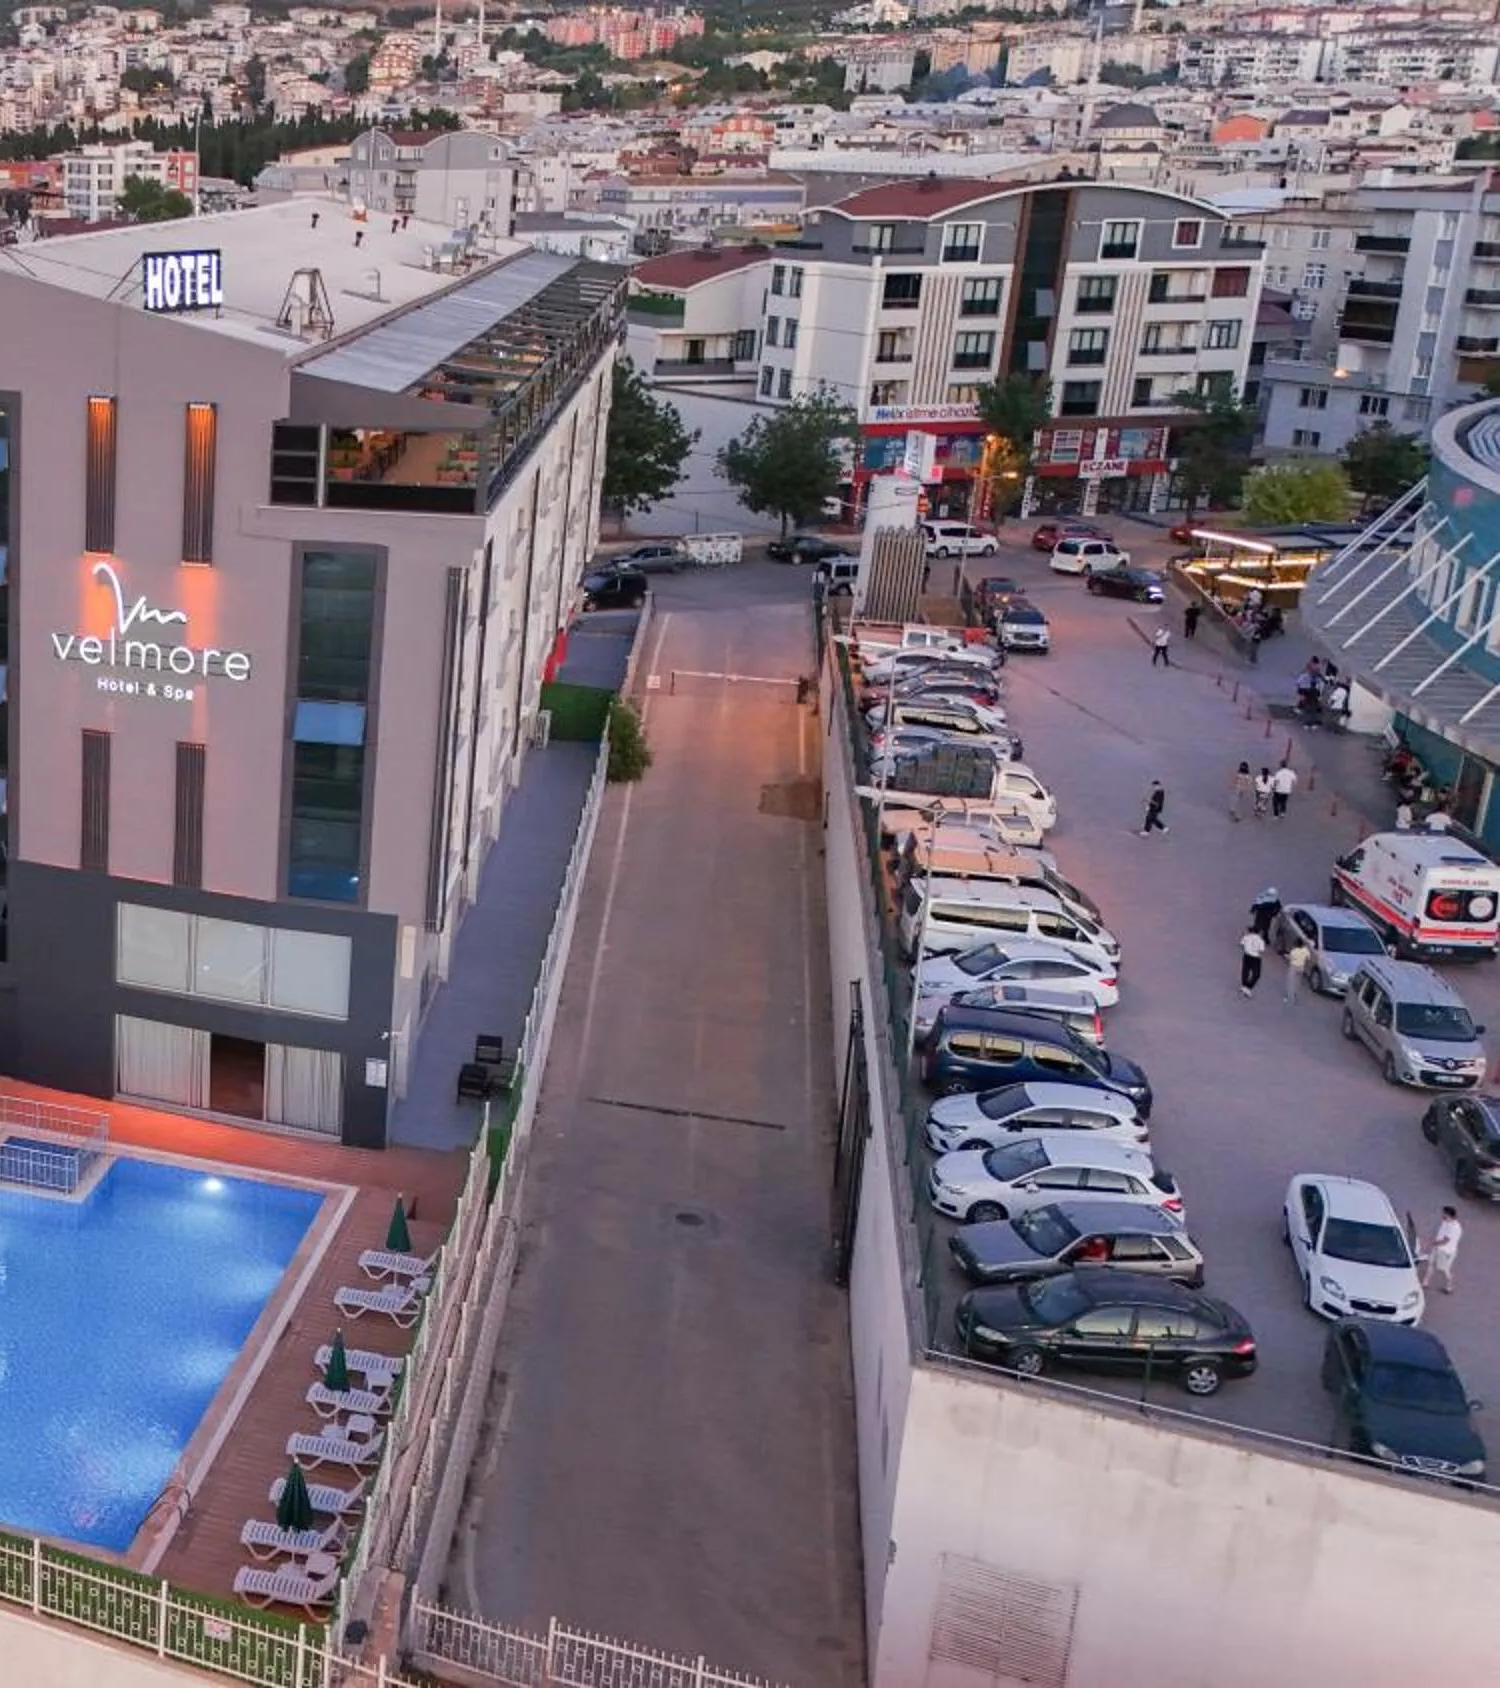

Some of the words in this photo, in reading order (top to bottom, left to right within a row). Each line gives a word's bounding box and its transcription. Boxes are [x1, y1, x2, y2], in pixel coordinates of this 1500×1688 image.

[147, 254, 223, 309] HOTEL
[51, 627, 251, 681] velmore
[97, 677, 140, 695] Hotel
[147, 684, 157, 697] &
[163, 685, 194, 701] Spa
